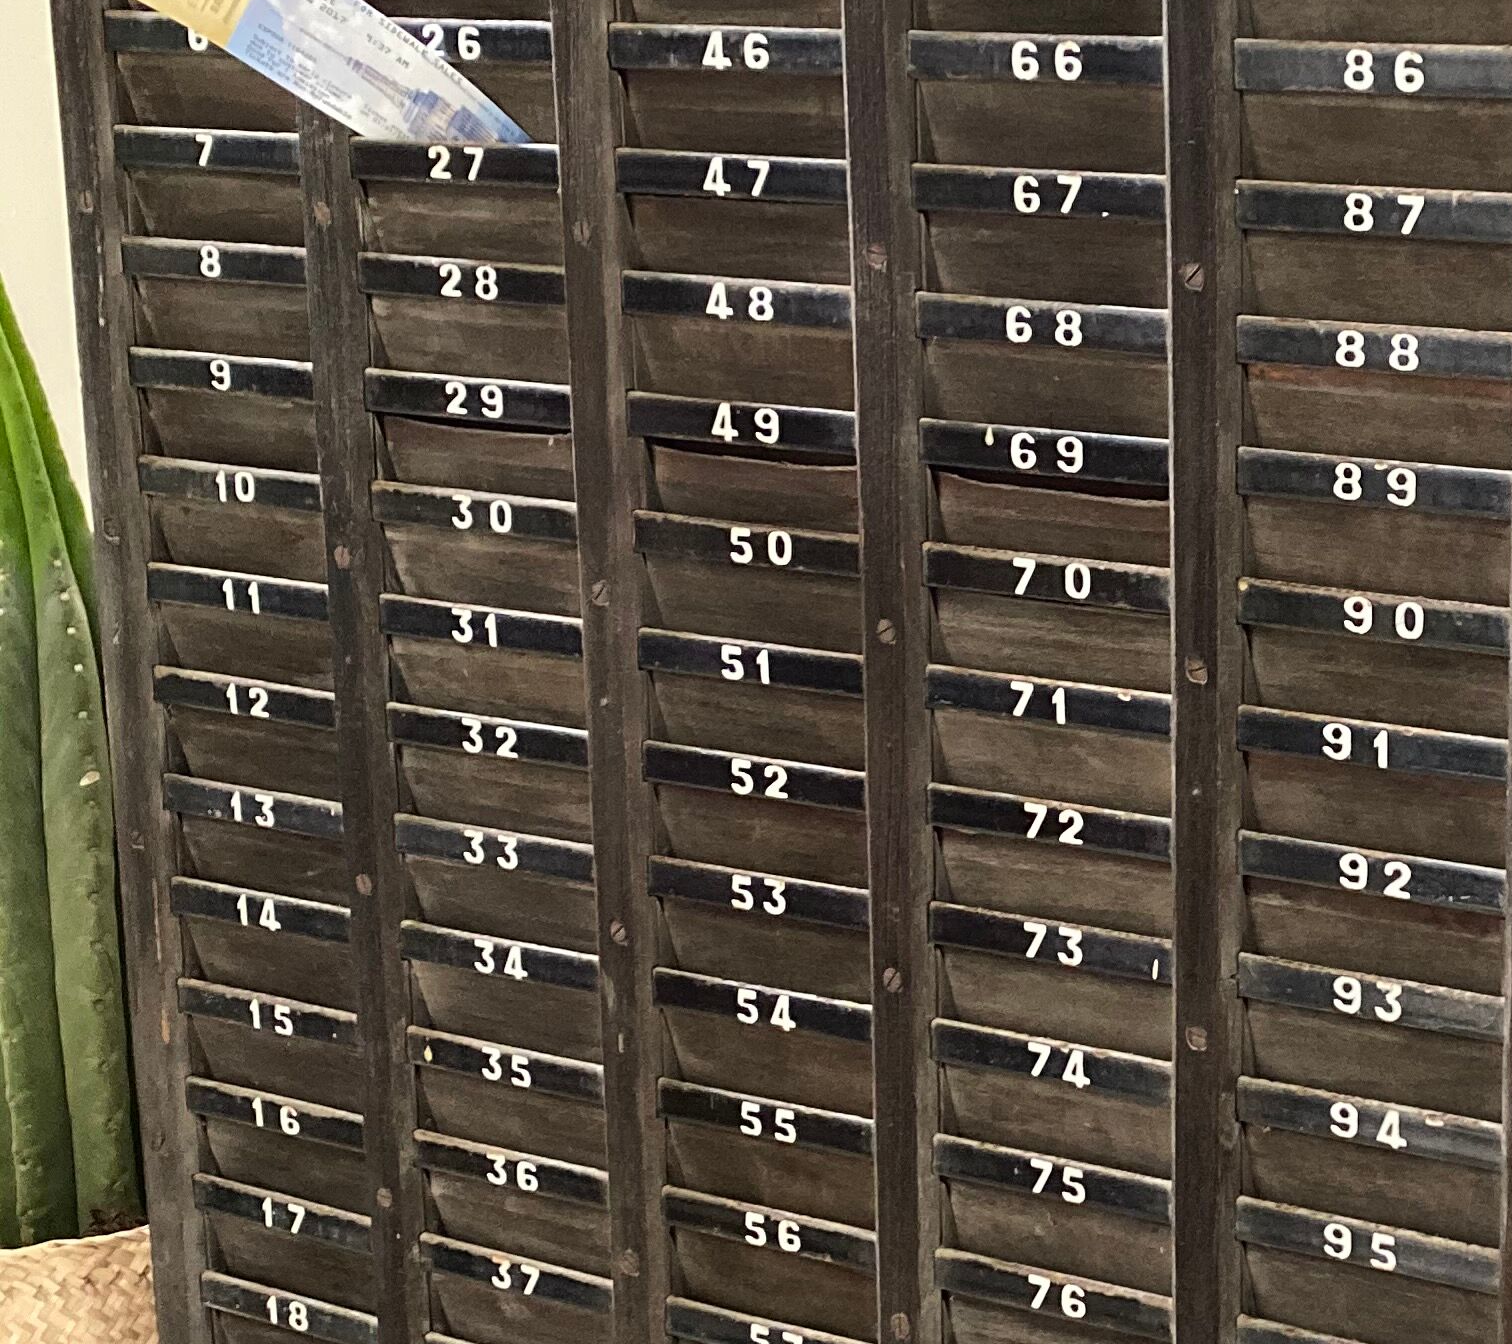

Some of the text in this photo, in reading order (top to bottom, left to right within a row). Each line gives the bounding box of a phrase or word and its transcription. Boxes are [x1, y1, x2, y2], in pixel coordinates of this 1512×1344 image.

[393, 56, 414, 68] AM
[422, 24, 482, 61] 26
[703, 31, 770, 70] 46
[1011, 40, 1083, 81] 66
[1343, 48, 1426, 94] 86
[195, 134, 214, 167] 7
[427, 145, 484, 182] 27
[703, 157, 770, 197] 47
[1013, 175, 1082, 214] 67
[200, 246, 222, 278] 8
[439, 264, 499, 301] 28
[1335, 330, 1420, 372] 88
[209, 360, 232, 392] 9
[712, 403, 780, 445] 49
[1010, 432, 1084, 474] 69
[215, 471, 256, 503] 10
[1332, 462, 1417, 507] 89
[451, 498, 513, 534] 30
[730, 527, 793, 566] 50
[222, 578, 261, 615] 11
[1012, 559, 1091, 600] 70
[451, 609, 498, 648] 31
[1343, 597, 1425, 640] 90
[720, 644, 770, 685] 51
[225, 683, 270, 719] 12
[1010, 681, 1066, 725] 71
[461, 721, 519, 759] 32
[730, 875, 787, 916] 53
[1338, 853, 1412, 900] 92
[236, 894, 282, 932] 14
[473, 942, 528, 980] 34
[1023, 922, 1083, 967] 73
[249, 1000, 294, 1036] 15
[736, 988, 796, 1032] 54
[1332, 976, 1402, 1023] 93
[481, 1046, 532, 1088] 35
[1028, 1043, 1091, 1089] 74
[1329, 1101, 1408, 1150] 94
[1030, 1161, 1086, 1204] 75
[261, 1197, 306, 1234] 17
[744, 1212, 802, 1253] 56
[491, 1256, 540, 1295] 37
[266, 1296, 315, 1332] 18
